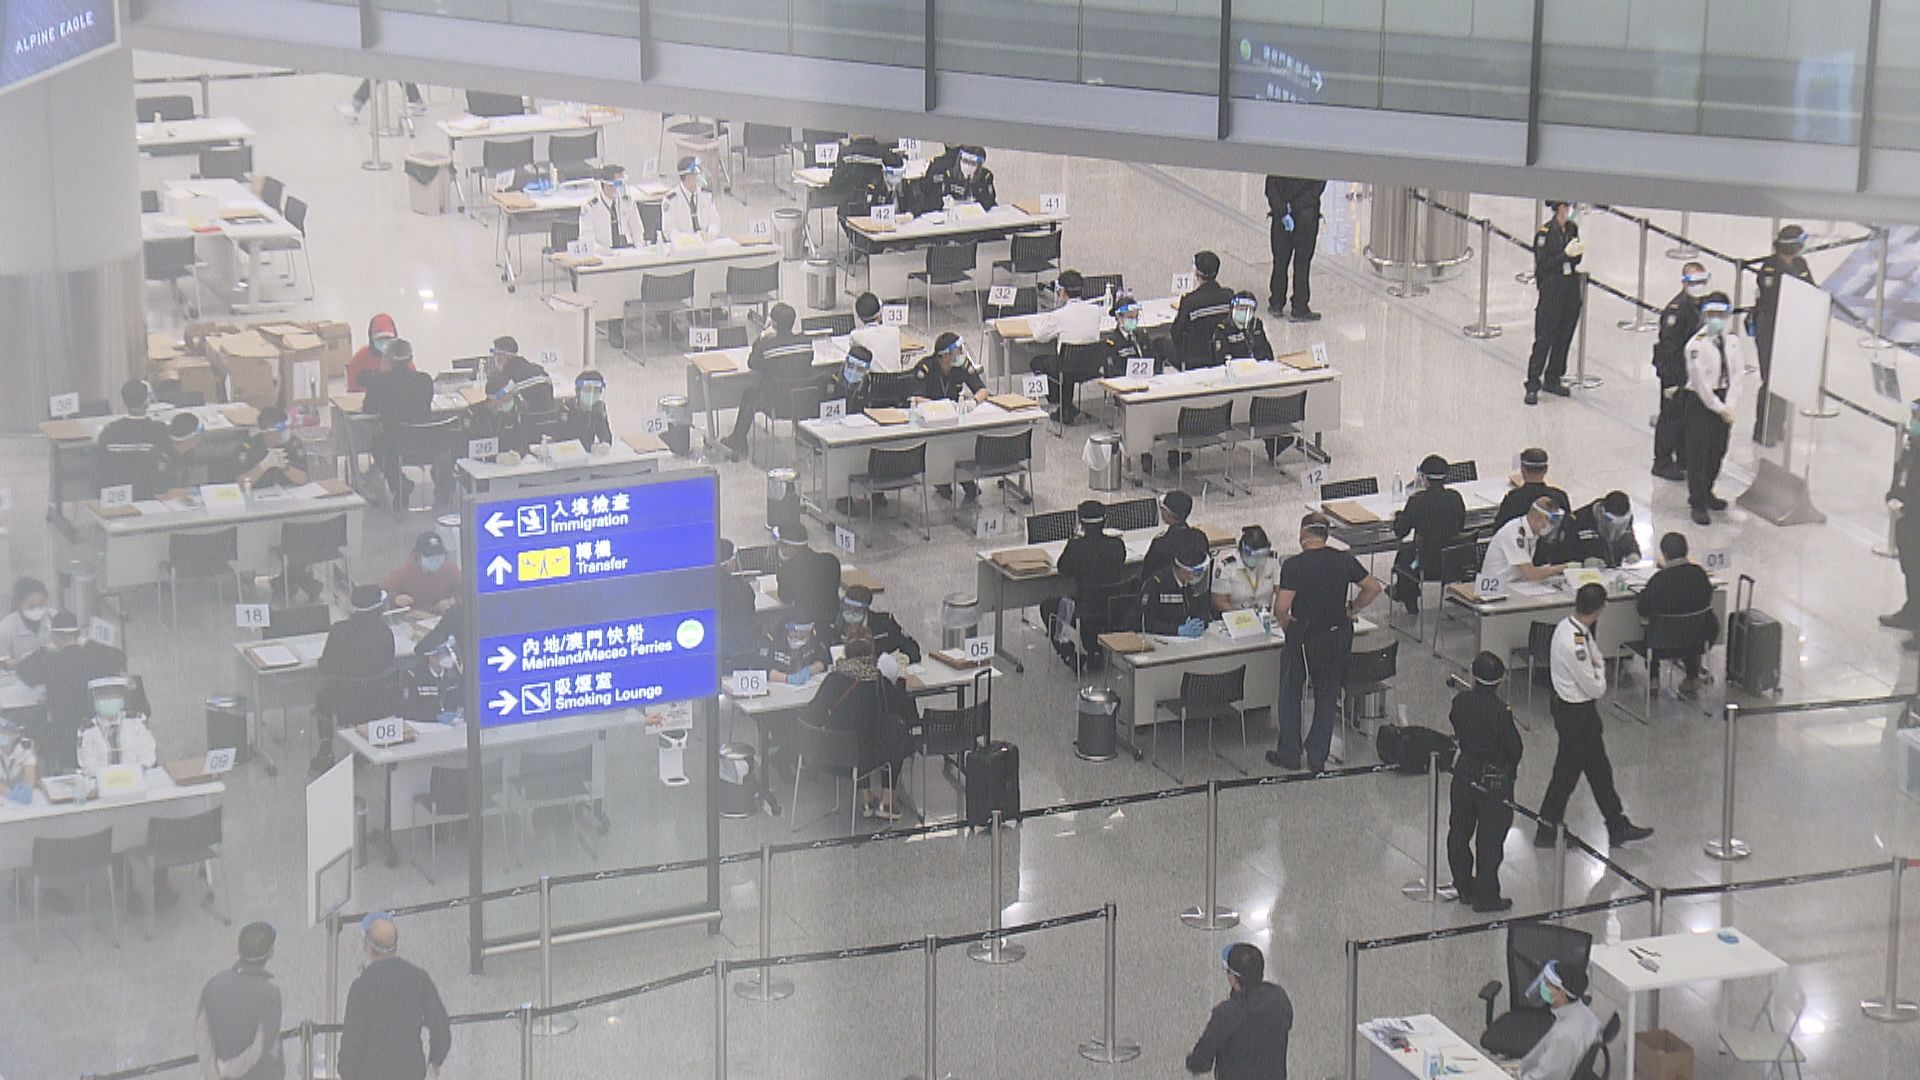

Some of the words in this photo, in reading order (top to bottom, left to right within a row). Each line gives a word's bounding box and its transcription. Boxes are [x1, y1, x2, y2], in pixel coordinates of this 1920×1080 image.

[16, 26, 55, 54] ALPINE
[59, 11, 94, 38] EAGLE
[821, 148, 832, 158] 47
[1046, 198, 1060, 209] 41
[876, 208, 889, 219] 42
[753, 223, 767, 234] 43
[1177, 278, 1188, 288] 31
[996, 288, 1011, 298] 32
[888, 310, 903, 321] 33
[696, 332, 710, 343] 34
[1132, 362, 1148, 373] 22
[1028, 381, 1044, 393] 23
[825, 405, 840, 416] 24
[647, 420, 662, 433] 25
[475, 442, 491, 453] 26
[1307, 471, 1322, 483] 12
[552, 492, 630, 518] 入境檢查
[551, 513, 629, 533] Immigration
[983, 520, 996, 532] 14
[839, 534, 851, 549] 15
[576, 539, 612, 561] 轉機
[1707, 553, 1724, 565] 01
[576, 556, 628, 575] Transfer
[1481, 579, 1500, 591] 02
[244, 609, 261, 621] 18
[970, 641, 988, 656] 05
[522, 647, 627, 671] Mainland/Macao
[630, 640, 673, 656] Ferries
[554, 671, 612, 695] 吸煙室
[740, 676, 759, 689] 06
[555, 692, 611, 711] Smoking
[615, 685, 662, 702] Lounge
[376, 723, 396, 738] 08
